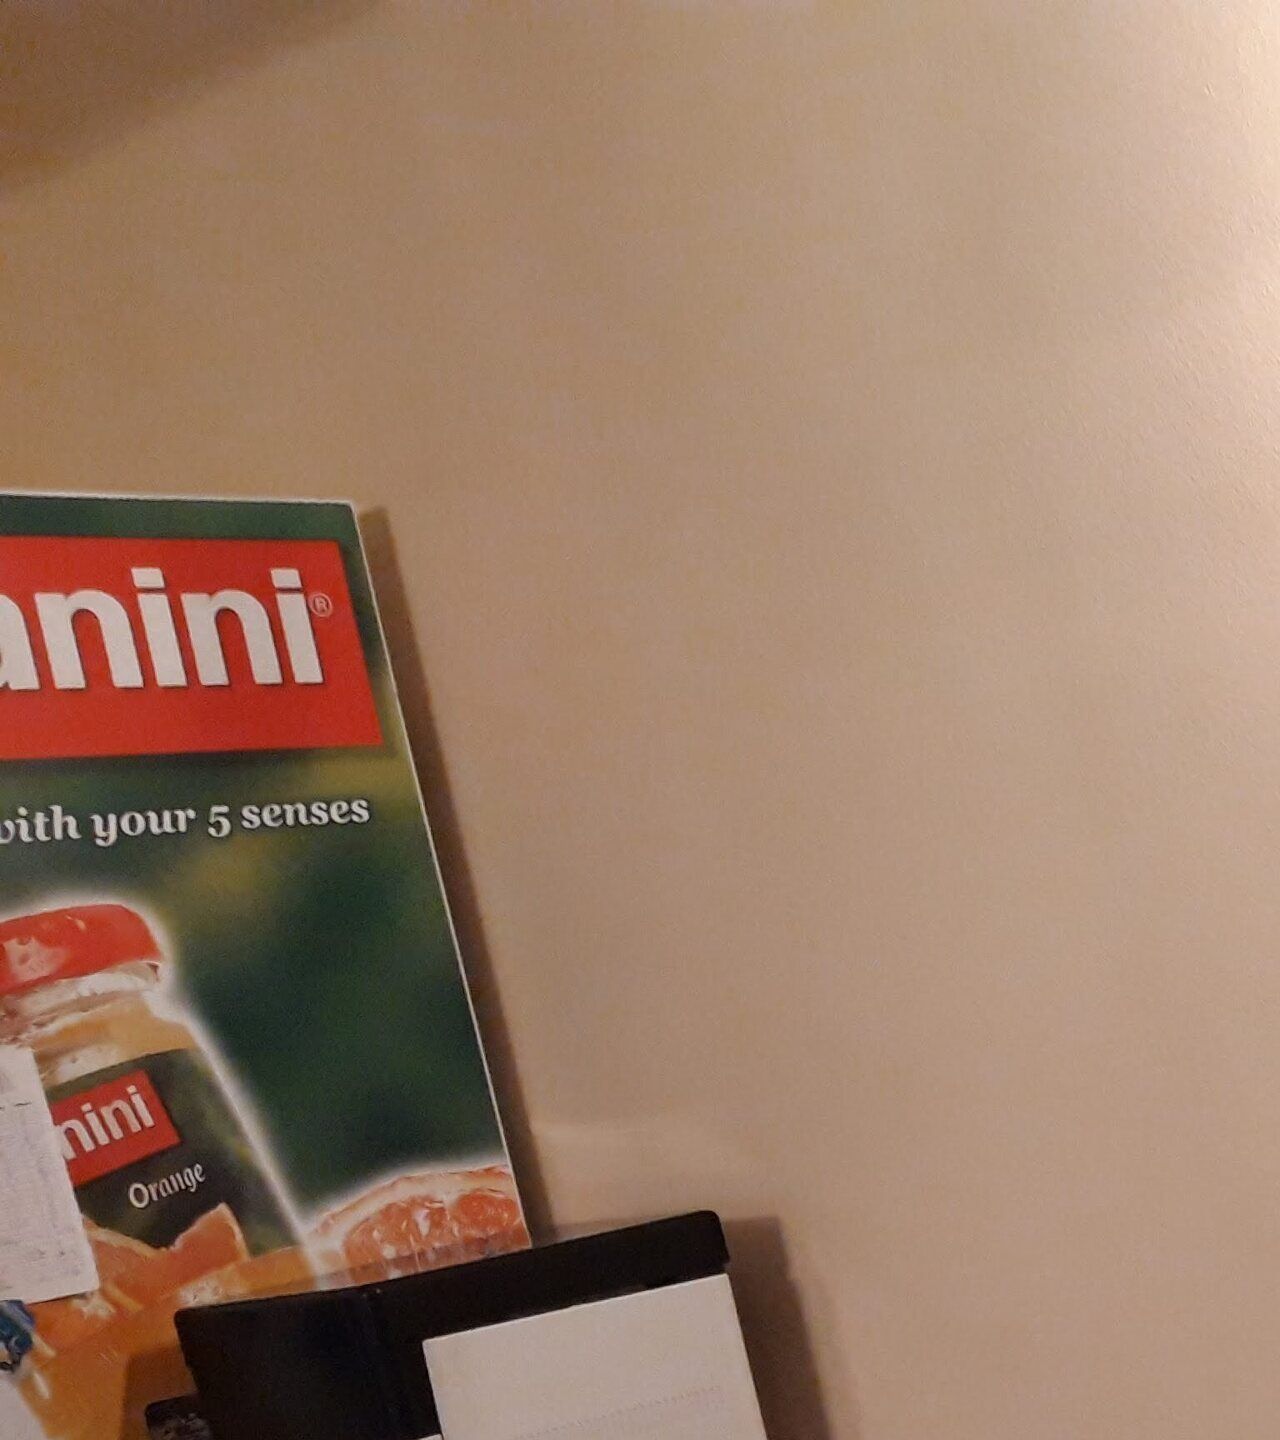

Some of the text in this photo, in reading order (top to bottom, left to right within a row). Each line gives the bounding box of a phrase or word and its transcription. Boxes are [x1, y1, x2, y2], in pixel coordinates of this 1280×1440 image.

[91, 808, 197, 847] your
[207, 804, 232, 838] 5
[241, 798, 370, 829] senses
[128, 1163, 206, 1209] Orange
